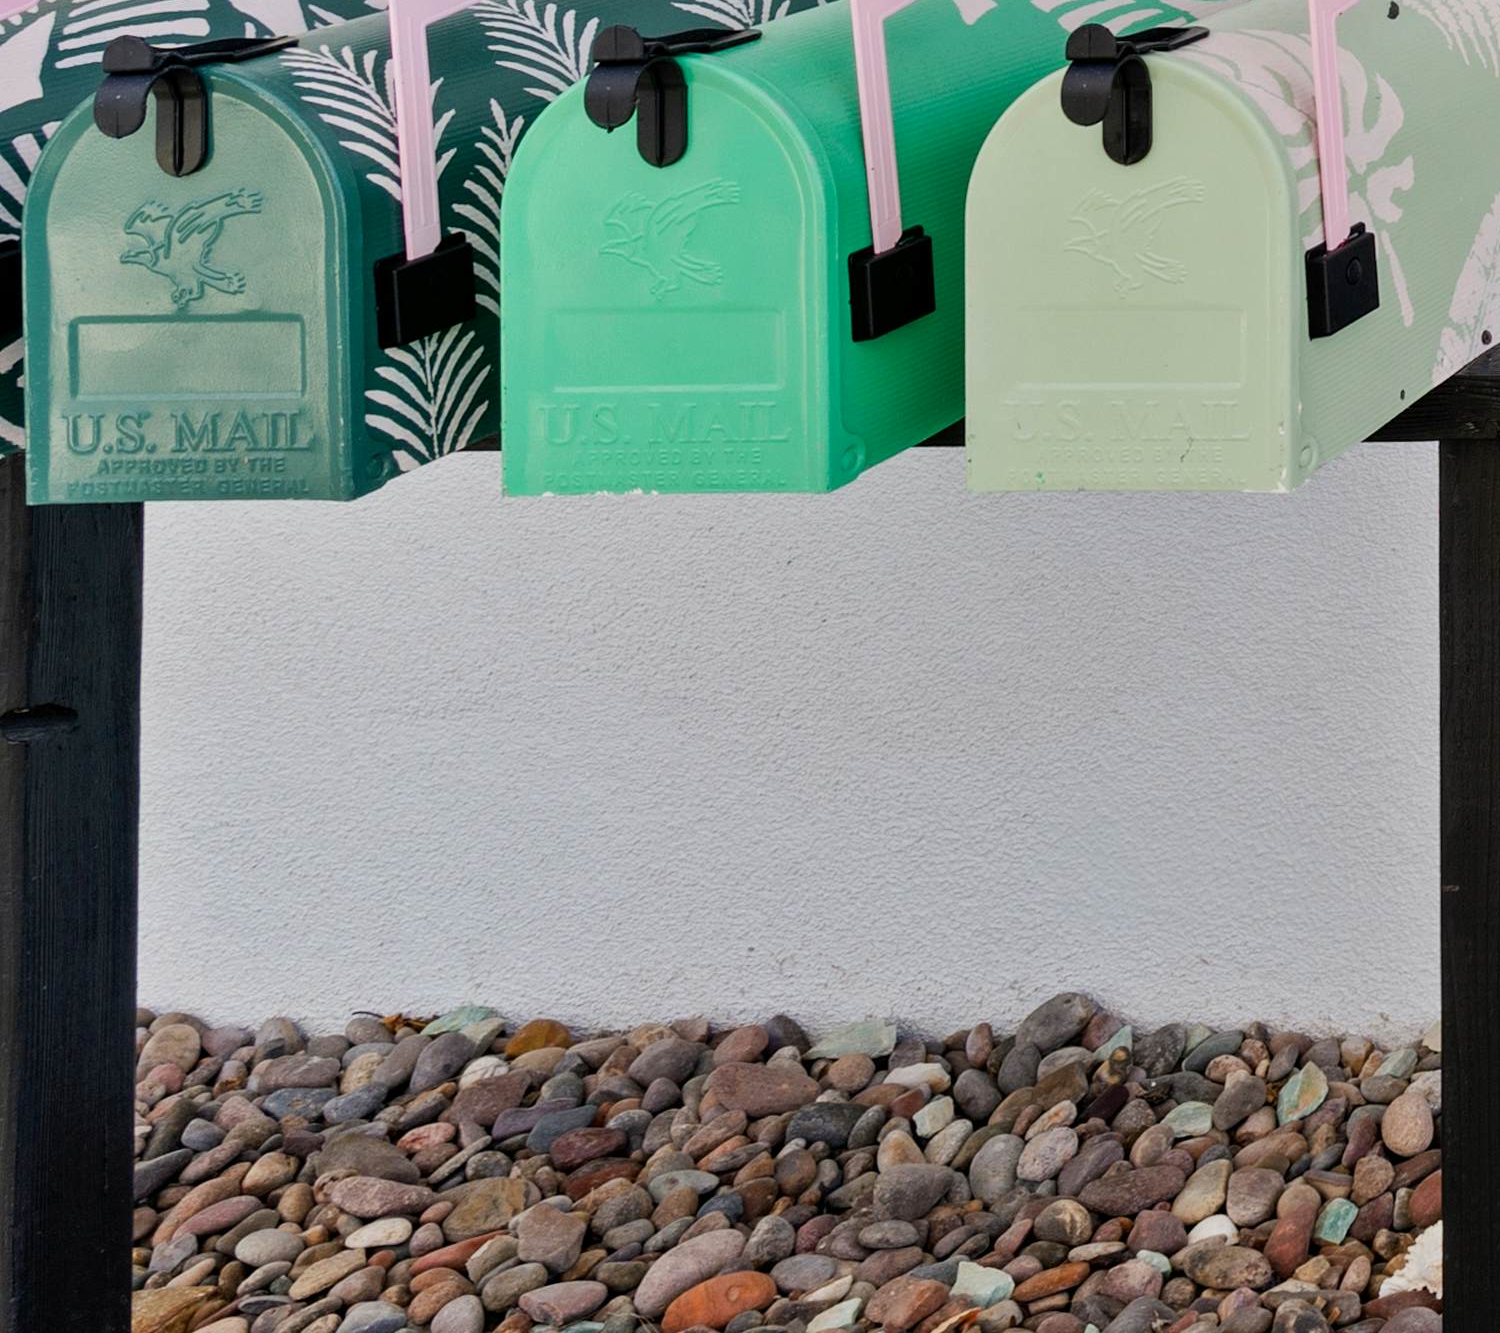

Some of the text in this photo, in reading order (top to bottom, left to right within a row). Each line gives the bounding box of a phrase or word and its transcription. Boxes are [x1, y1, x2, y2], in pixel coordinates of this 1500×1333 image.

[538, 401, 790, 445] U.S. MAIL
[1000, 398, 1255, 442] U.S. MAIL
[62, 411, 316, 455] U.S. MAIL
[97, 456, 286, 475] APPROVED BY THE
[690, 449, 715, 466] BY
[722, 447, 762, 465] THE
[67, 478, 310, 496] POSTMASTER GENERAL
[695, 469, 786, 487] GENERAL
